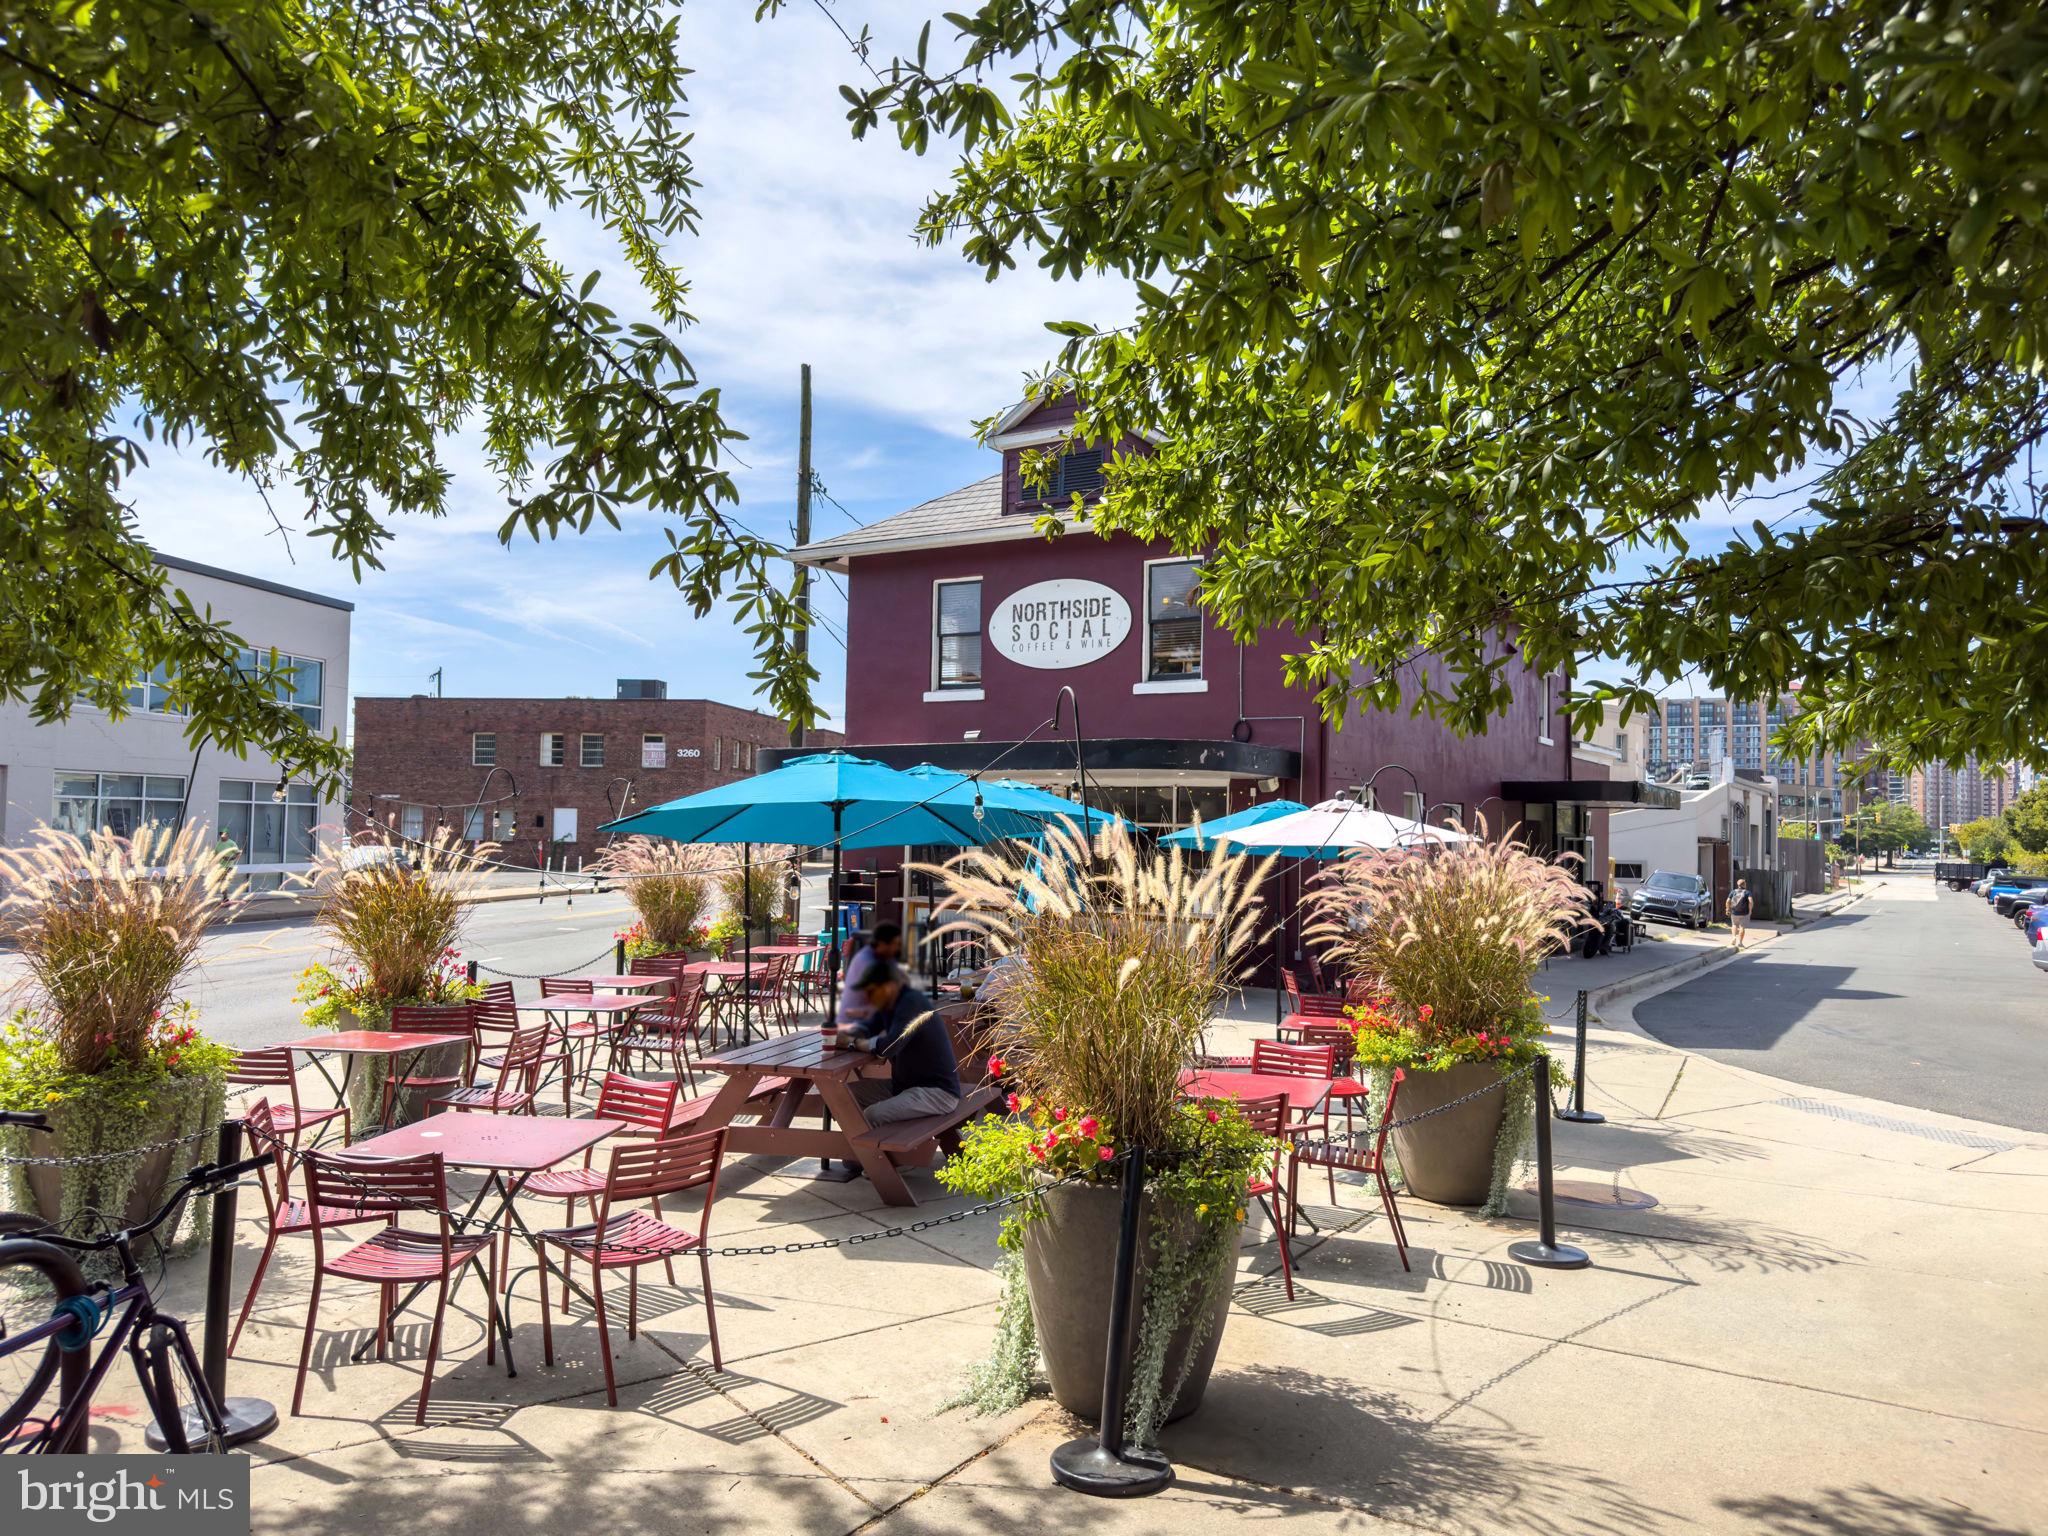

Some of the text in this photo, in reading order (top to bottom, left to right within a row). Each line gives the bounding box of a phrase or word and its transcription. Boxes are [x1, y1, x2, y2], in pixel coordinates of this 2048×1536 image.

[1012, 597, 1111, 623] NORTHSIDE
[1012, 618, 1111, 642] SOCIAL
[1011, 638, 1111, 653] COFFEE & WINE
[676, 748, 701, 758] 3260
